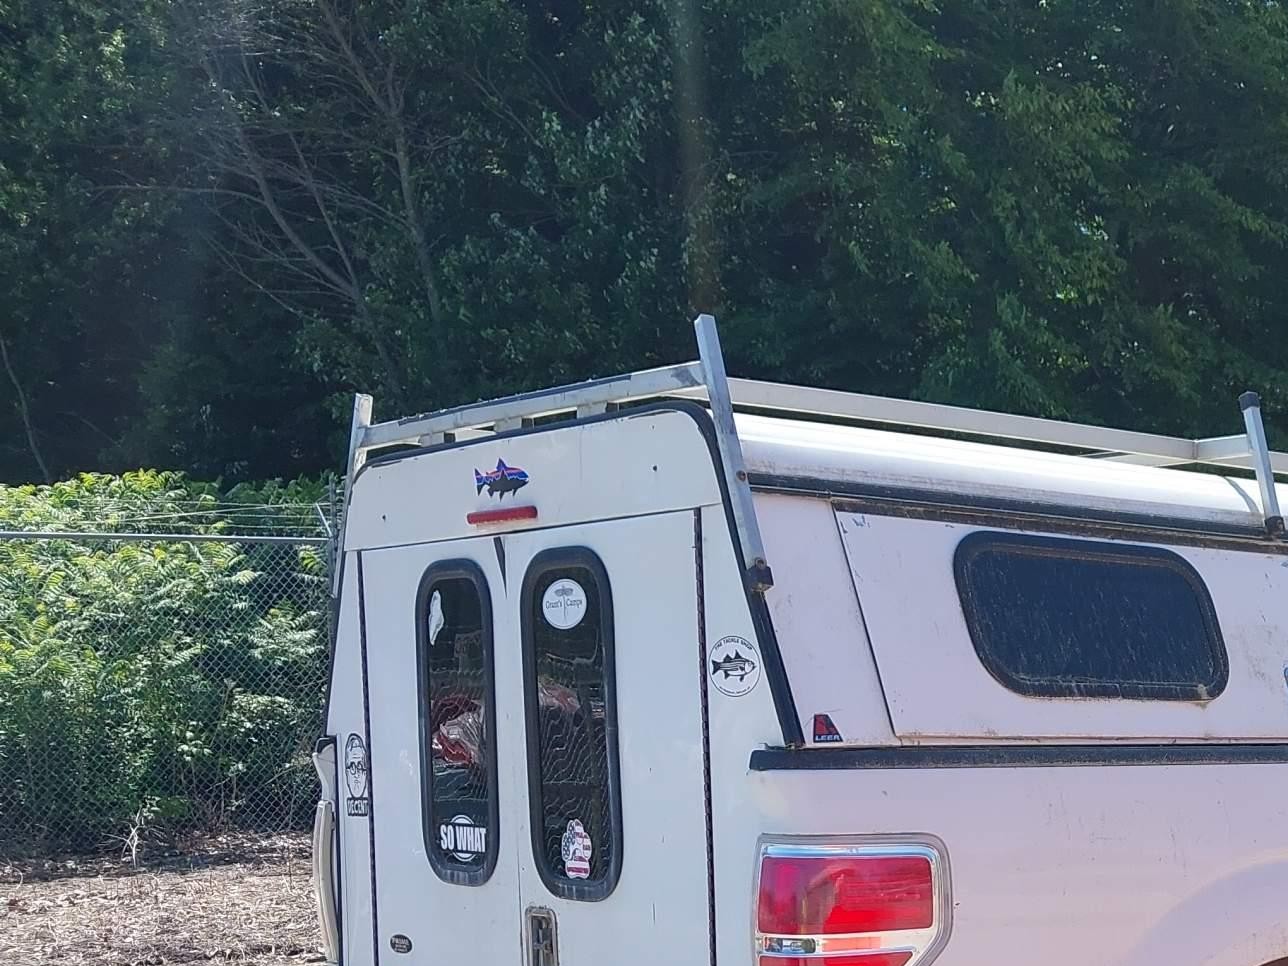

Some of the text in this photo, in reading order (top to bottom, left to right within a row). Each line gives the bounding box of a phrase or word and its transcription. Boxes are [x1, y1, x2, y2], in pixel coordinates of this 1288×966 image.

[347, 799, 369, 815] DECENT
[440, 824, 487, 853] SO WHAT
